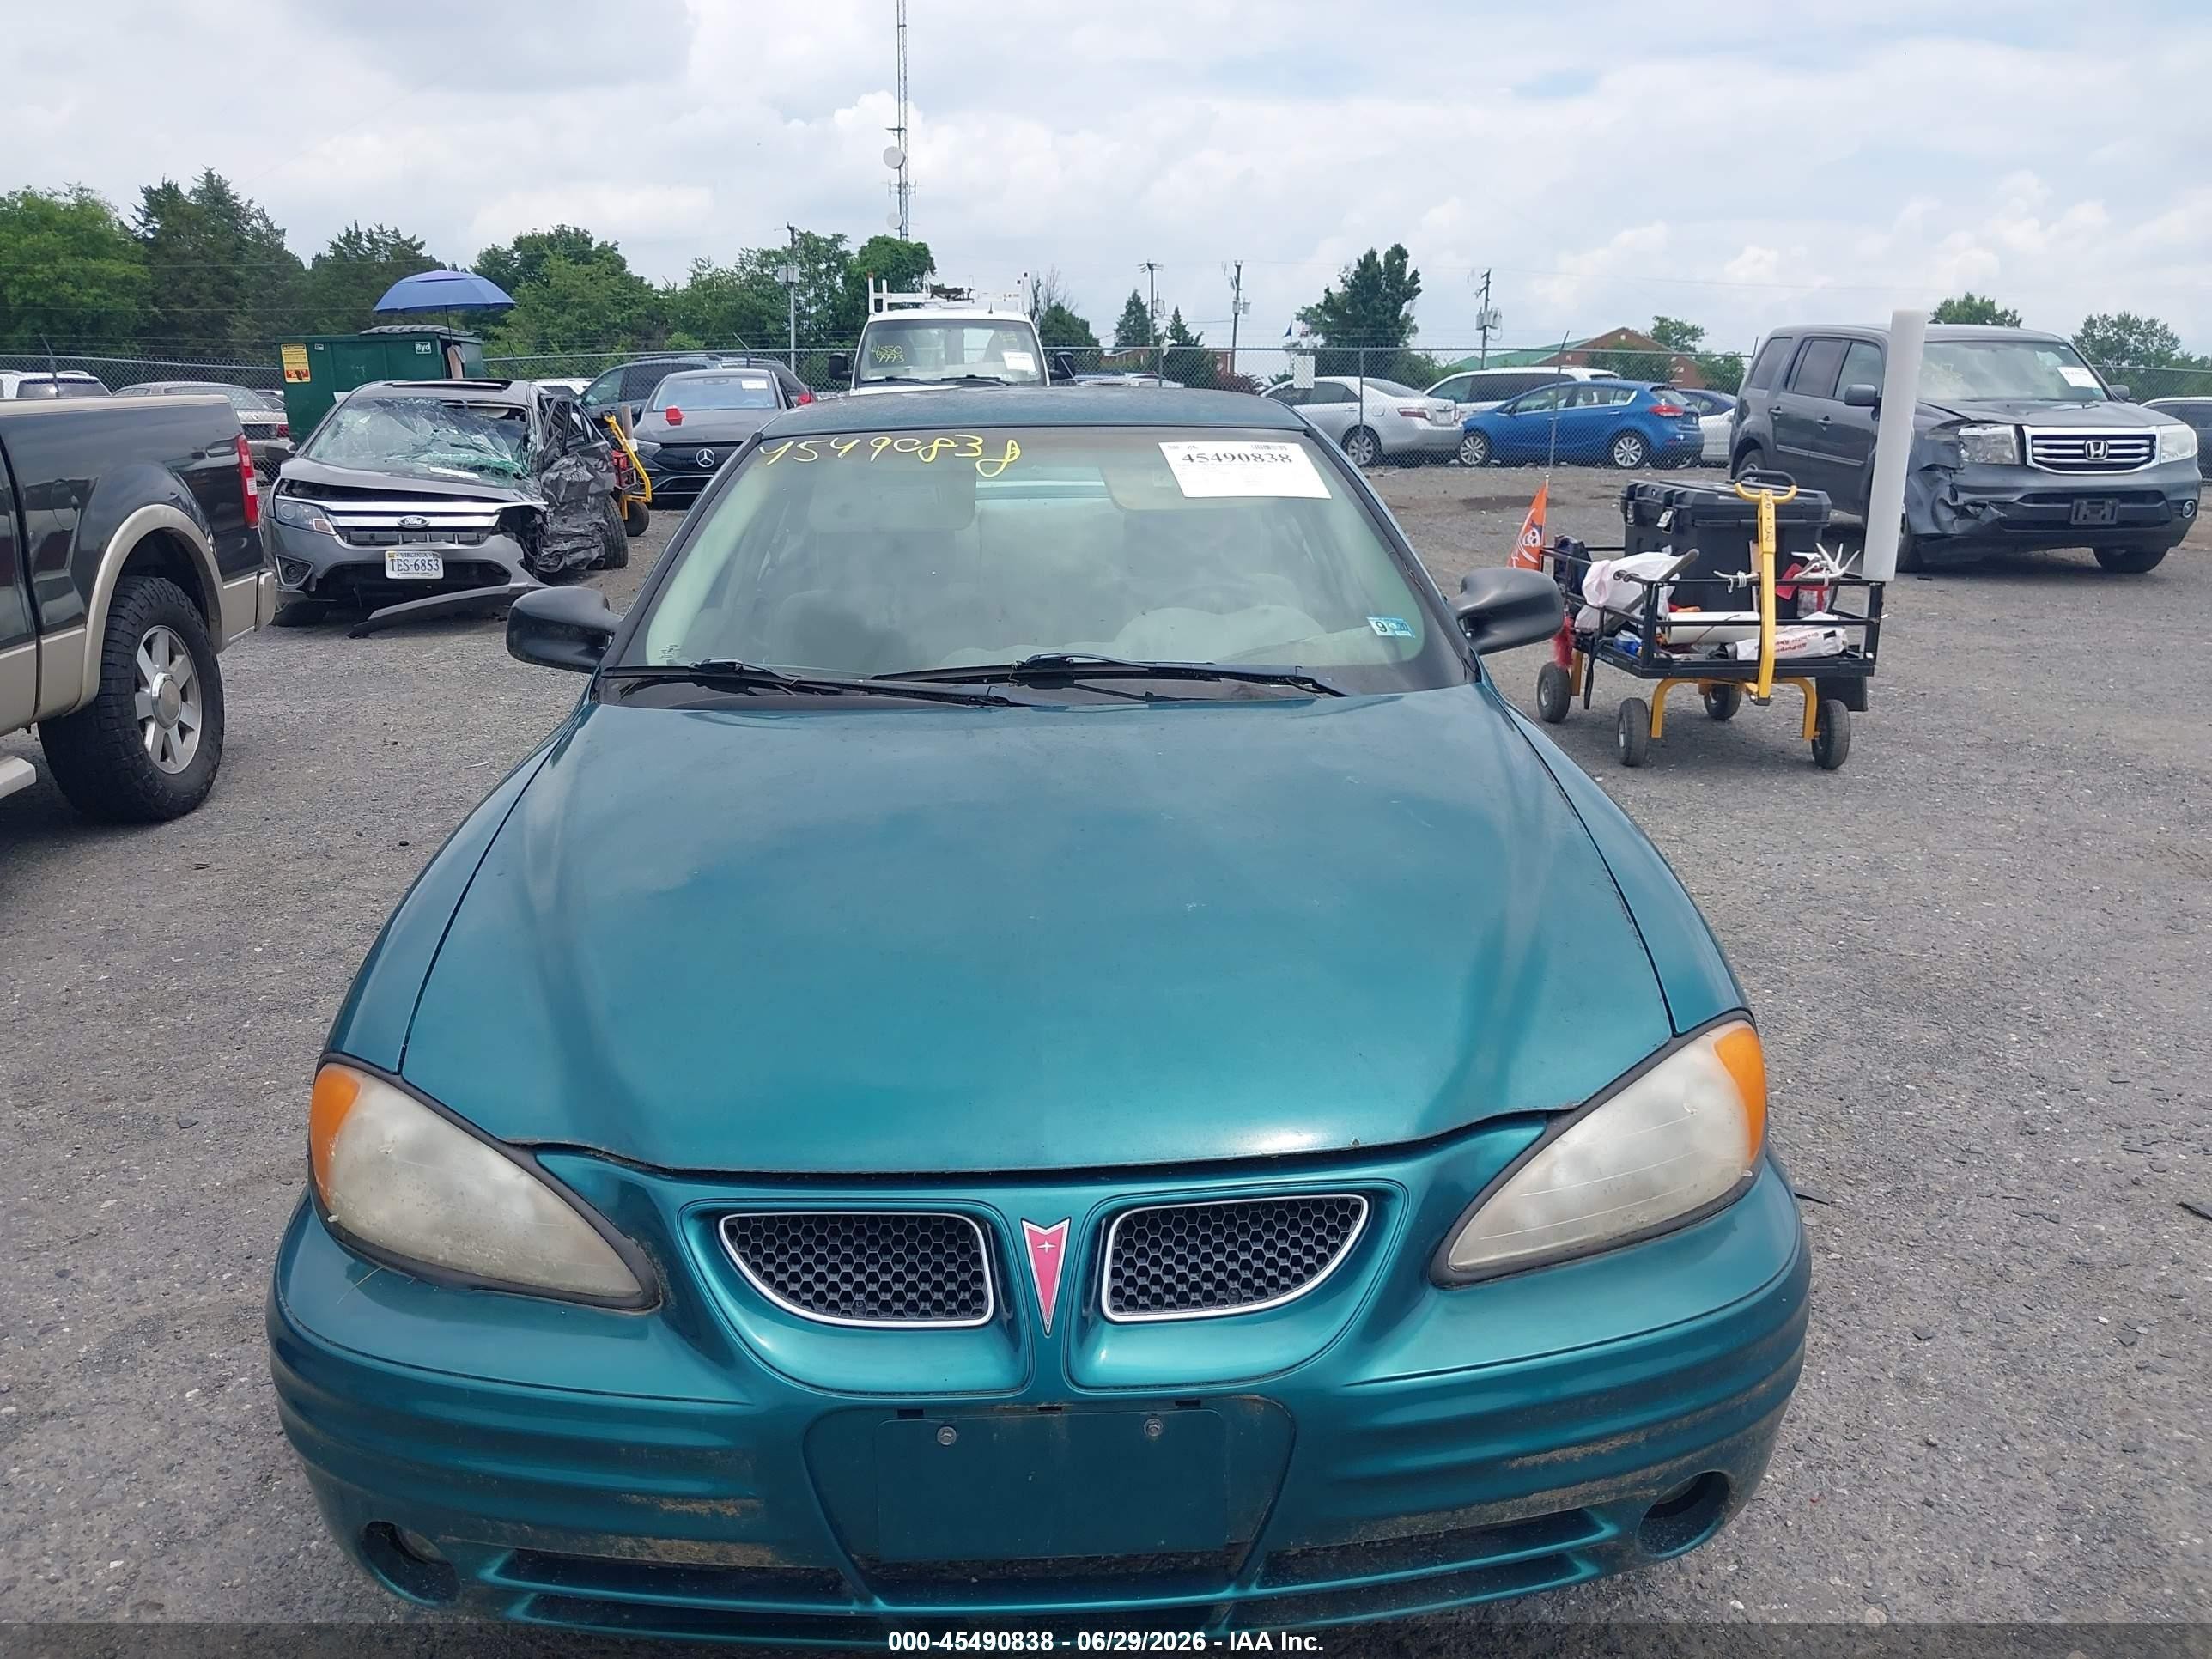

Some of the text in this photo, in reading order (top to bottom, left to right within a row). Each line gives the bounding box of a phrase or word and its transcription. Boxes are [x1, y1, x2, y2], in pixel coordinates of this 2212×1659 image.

[759, 434, 1021, 477] 45490838
[1182, 453, 1292, 463] 45490838
[390, 558, 440, 572] TES-6853
